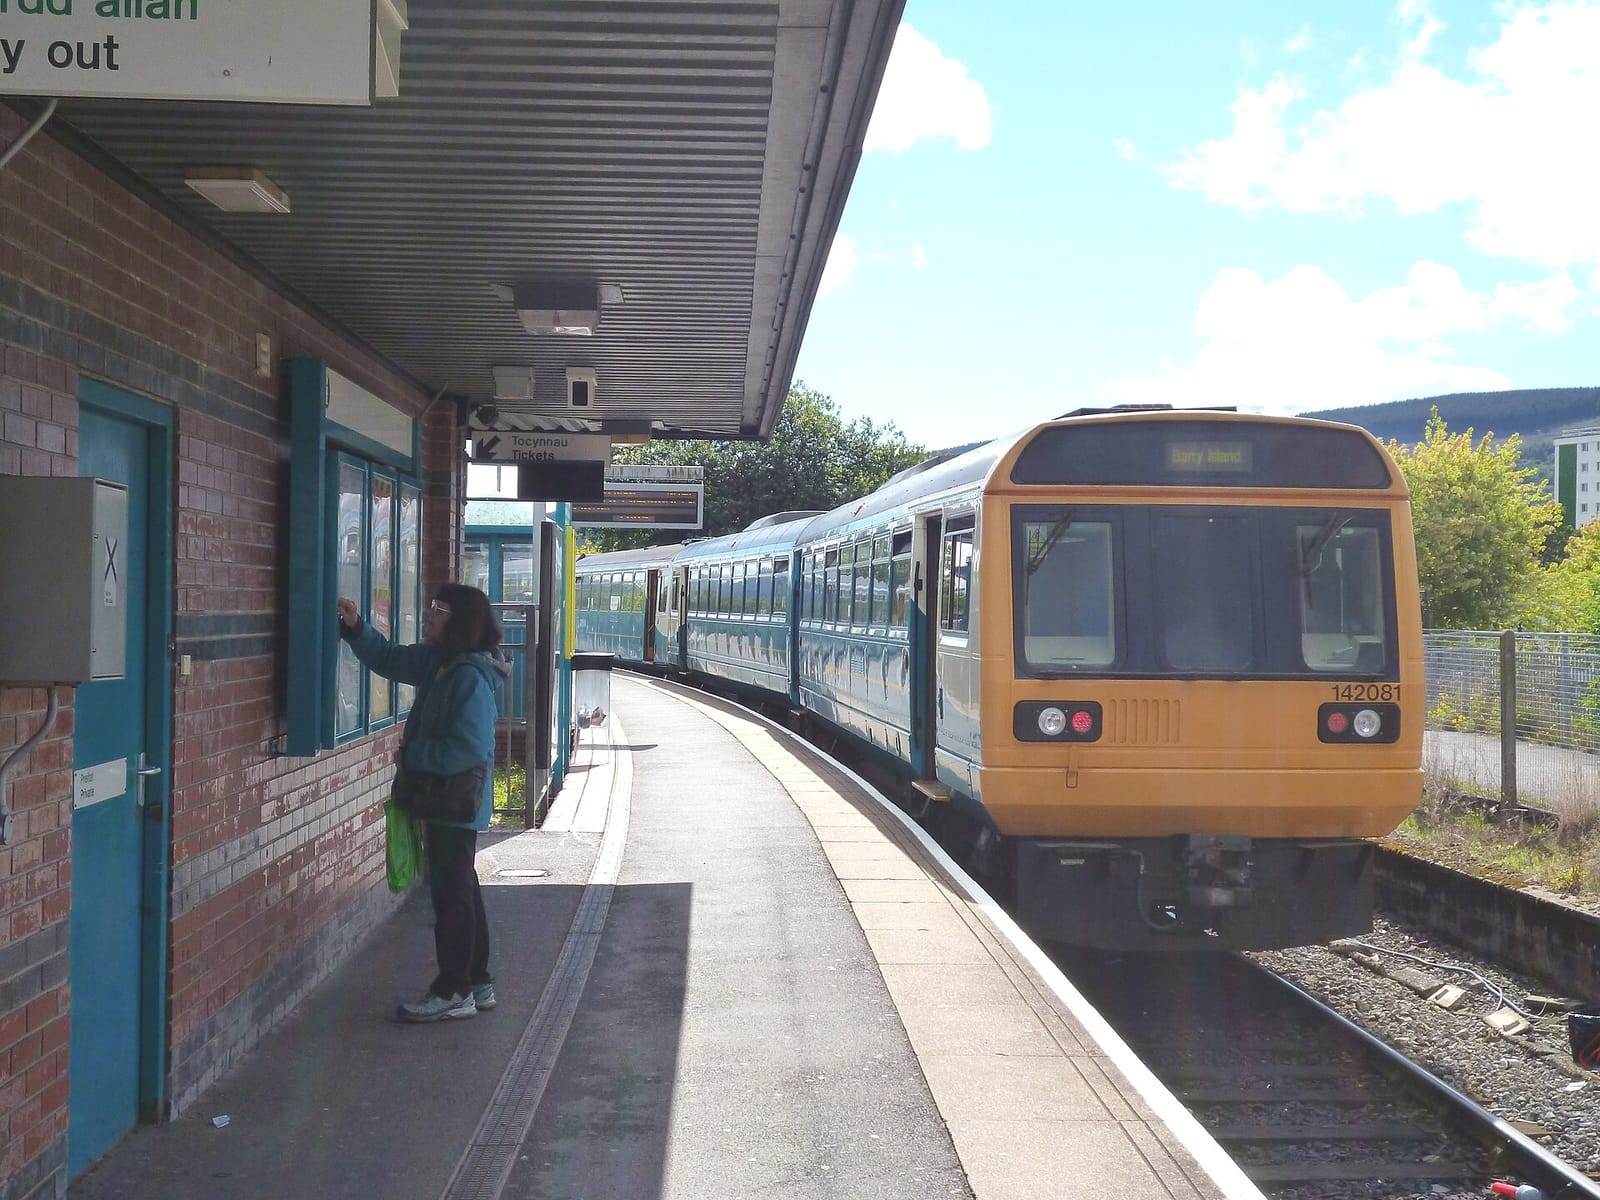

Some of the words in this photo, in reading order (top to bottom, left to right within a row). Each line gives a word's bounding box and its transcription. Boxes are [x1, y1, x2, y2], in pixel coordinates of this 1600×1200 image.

[47, 34, 120, 71] out
[511, 435, 568, 448] Tocynnau
[511, 449, 555, 461] Tickets
[1331, 684, 1401, 702] 142081
